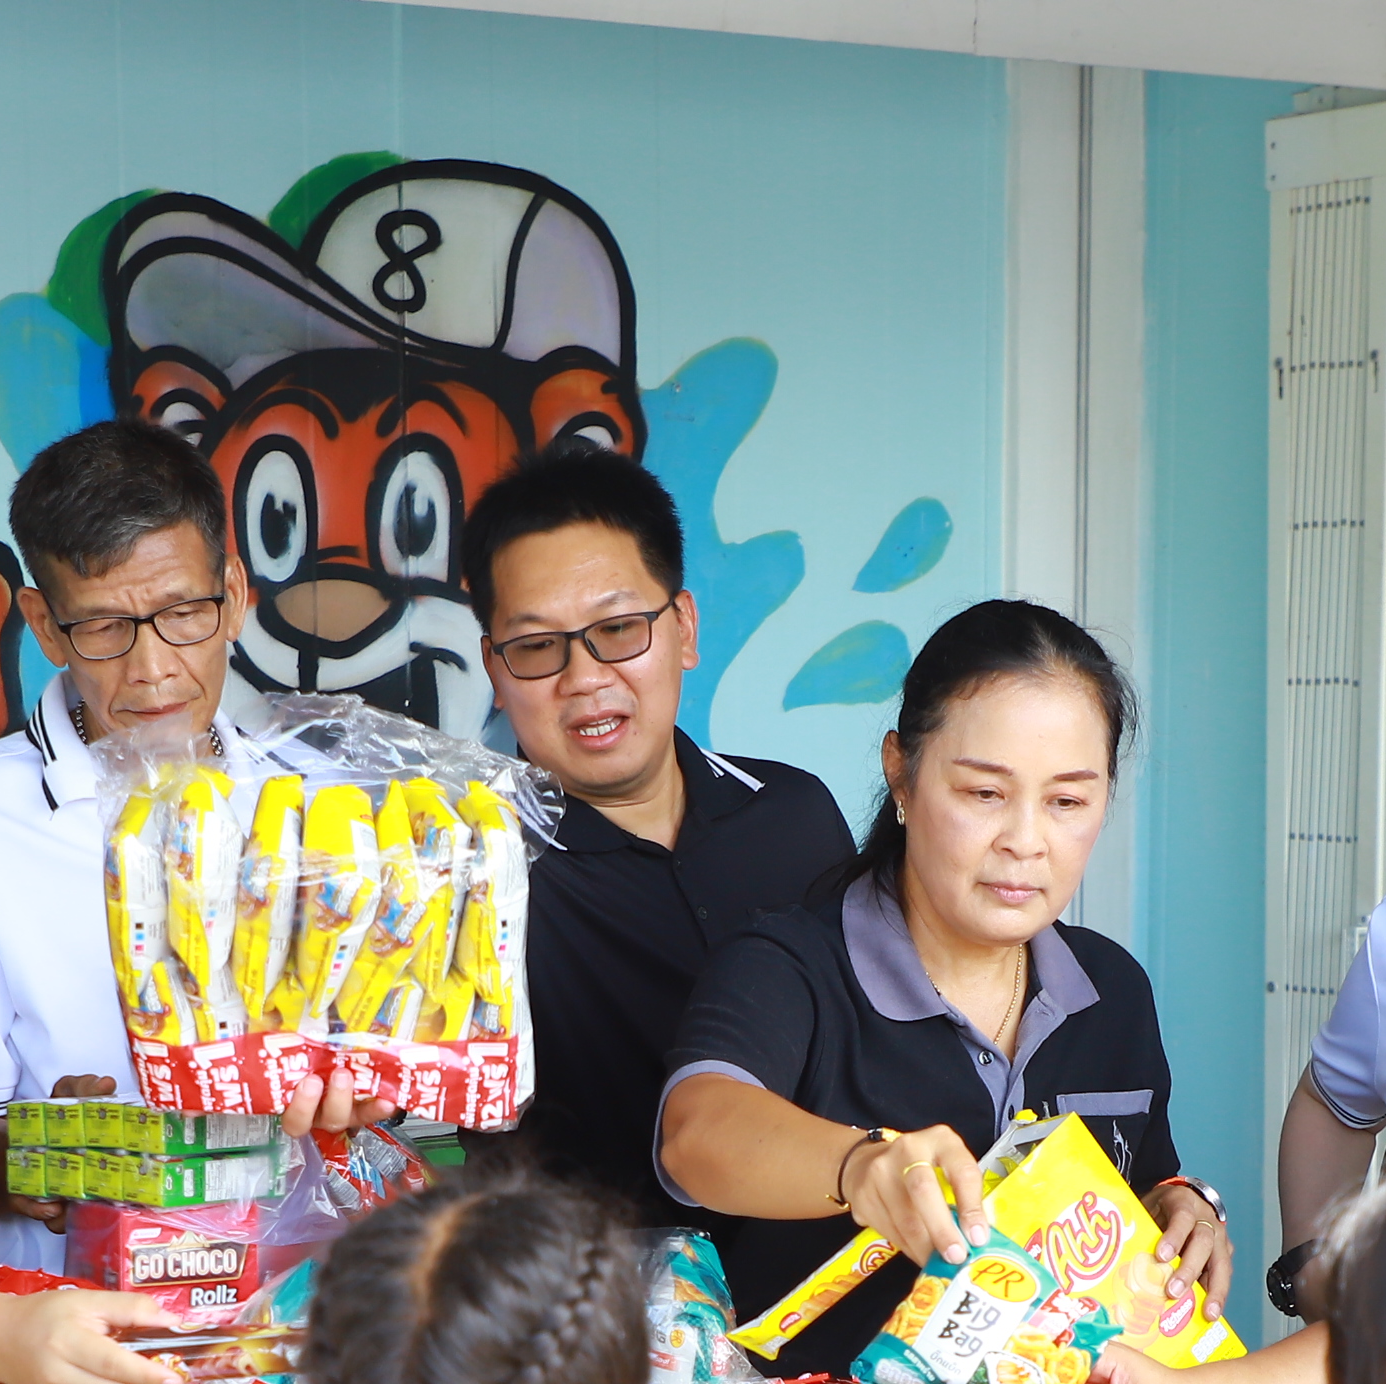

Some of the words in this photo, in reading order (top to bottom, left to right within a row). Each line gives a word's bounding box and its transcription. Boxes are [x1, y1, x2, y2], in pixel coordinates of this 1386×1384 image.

[372, 207, 444, 314] 8
[134, 1253, 165, 1281] GO
[166, 1248, 238, 1278] CHOCO
[972, 1261, 1025, 1298] PR
[190, 1284, 238, 1306] Rollz
[953, 1290, 1002, 1332] Big
[937, 1319, 983, 1358] Bag
